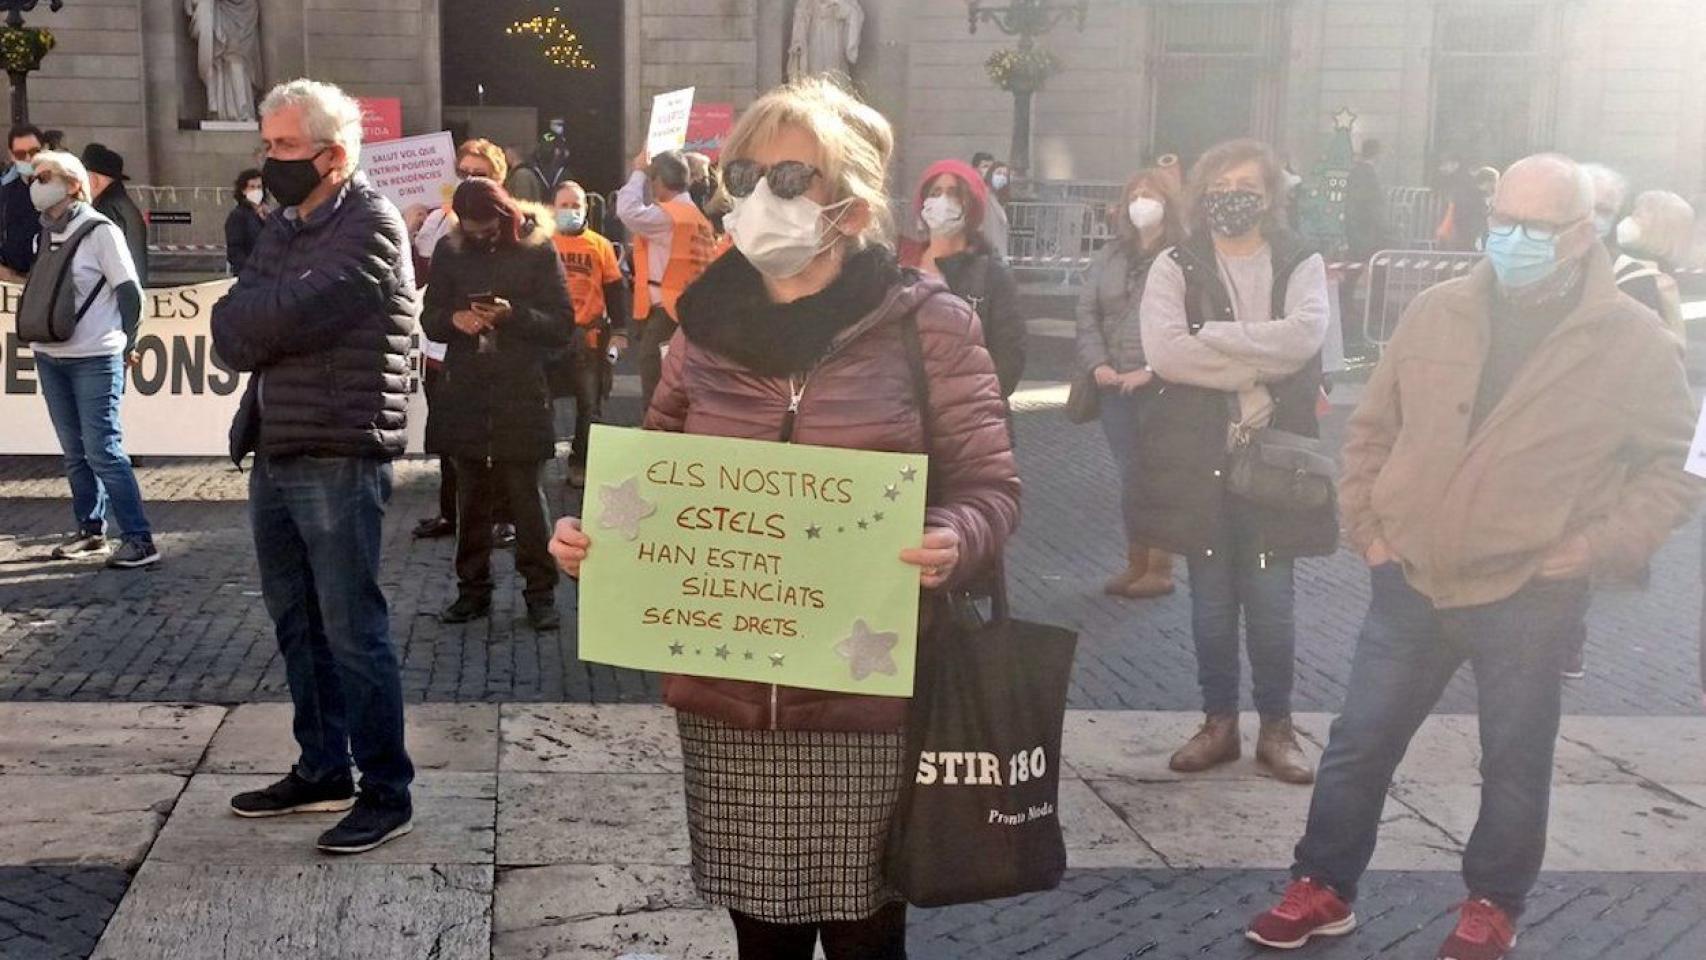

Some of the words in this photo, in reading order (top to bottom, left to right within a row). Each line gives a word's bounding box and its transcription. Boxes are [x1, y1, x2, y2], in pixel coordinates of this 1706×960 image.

[372, 151, 398, 163] SALUT
[400, 149, 417, 159] VOL
[418, 146, 437, 156] QUE
[377, 179, 388, 188] EN
[646, 460, 706, 488] ELS
[719, 465, 854, 503] NOSTRES
[676, 506, 786, 539] ESTELS
[637, 542, 696, 566] HAN
[707, 548, 783, 576] ESTAT
[642, 607, 722, 630] SENSE
[915, 750, 1002, 786] STIR
[1009, 746, 1047, 786] 180
